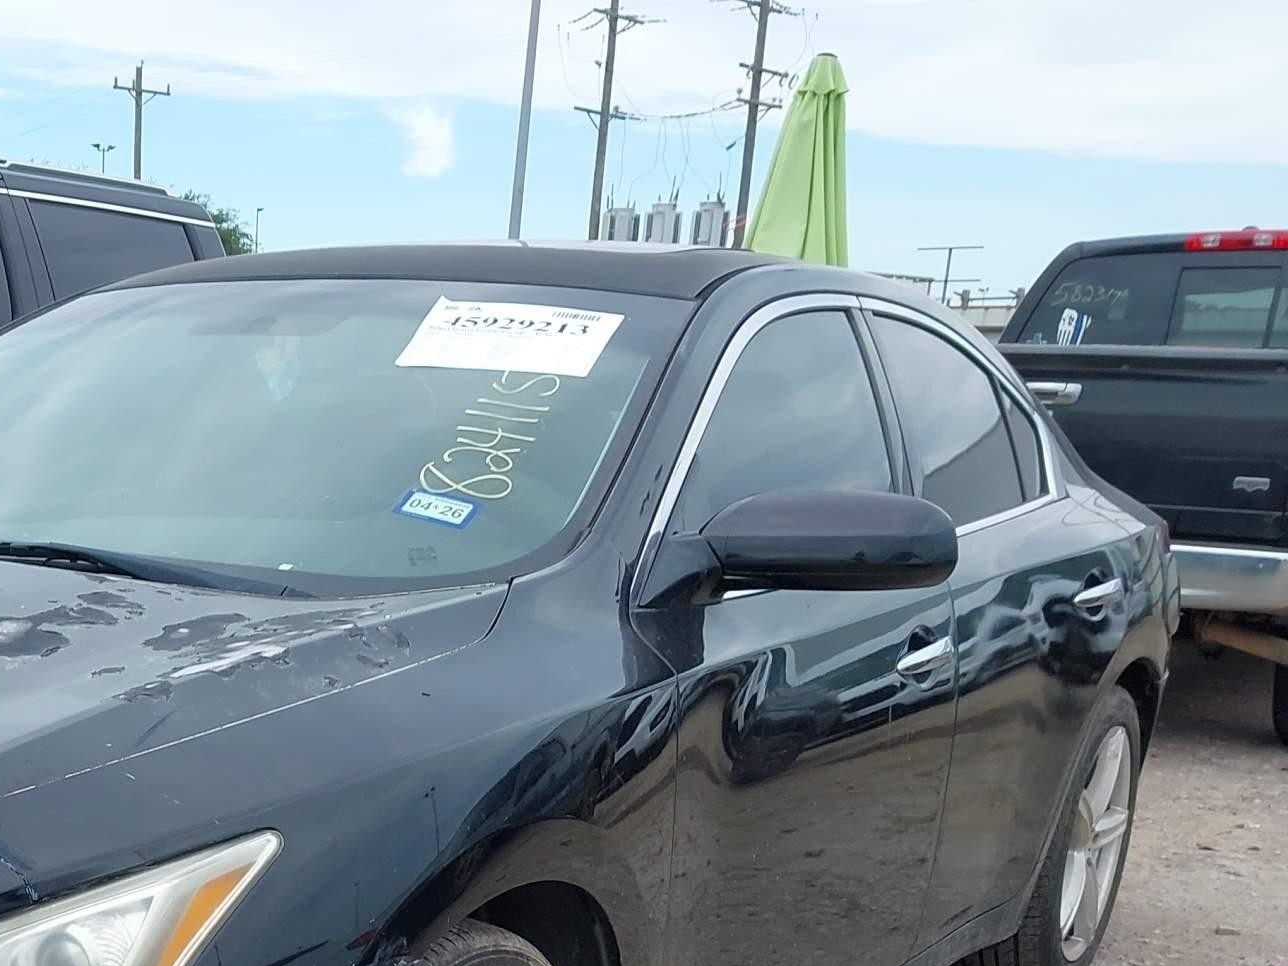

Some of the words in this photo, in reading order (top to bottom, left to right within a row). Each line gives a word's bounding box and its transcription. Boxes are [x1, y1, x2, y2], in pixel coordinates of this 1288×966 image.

[442, 315, 590, 335] 45929213
[409, 498, 433, 511] 04
[438, 505, 464, 519] 26
